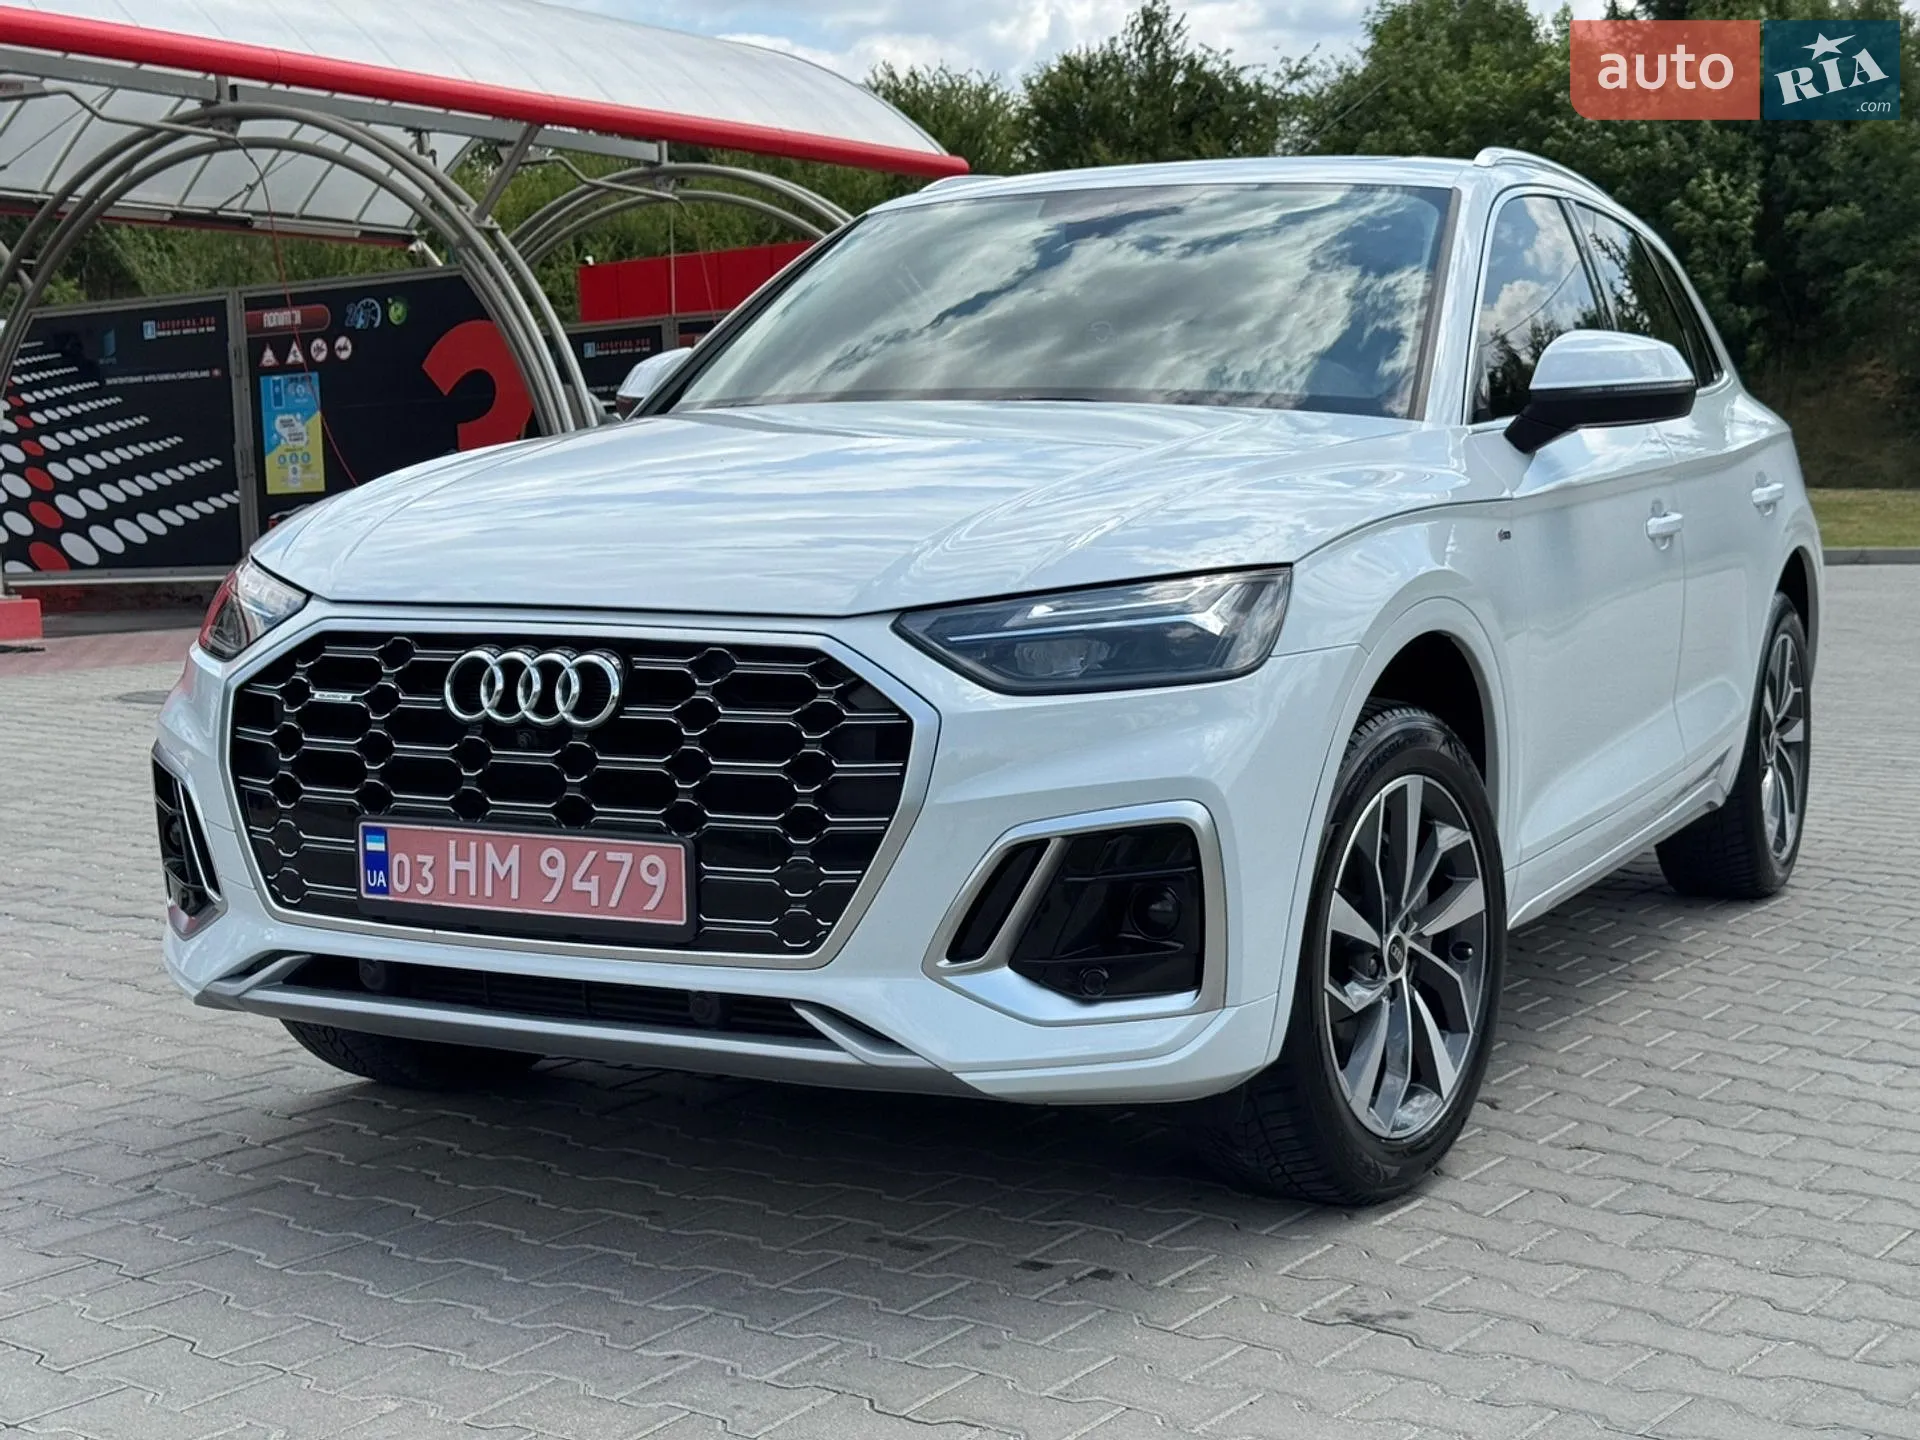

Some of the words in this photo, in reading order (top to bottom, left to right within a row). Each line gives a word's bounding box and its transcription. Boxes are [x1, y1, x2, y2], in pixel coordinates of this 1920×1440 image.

[366, 869, 387, 889] UA
[392, 852, 436, 896] 03
[448, 839, 521, 901] HM
[539, 847, 668, 912] 9479
